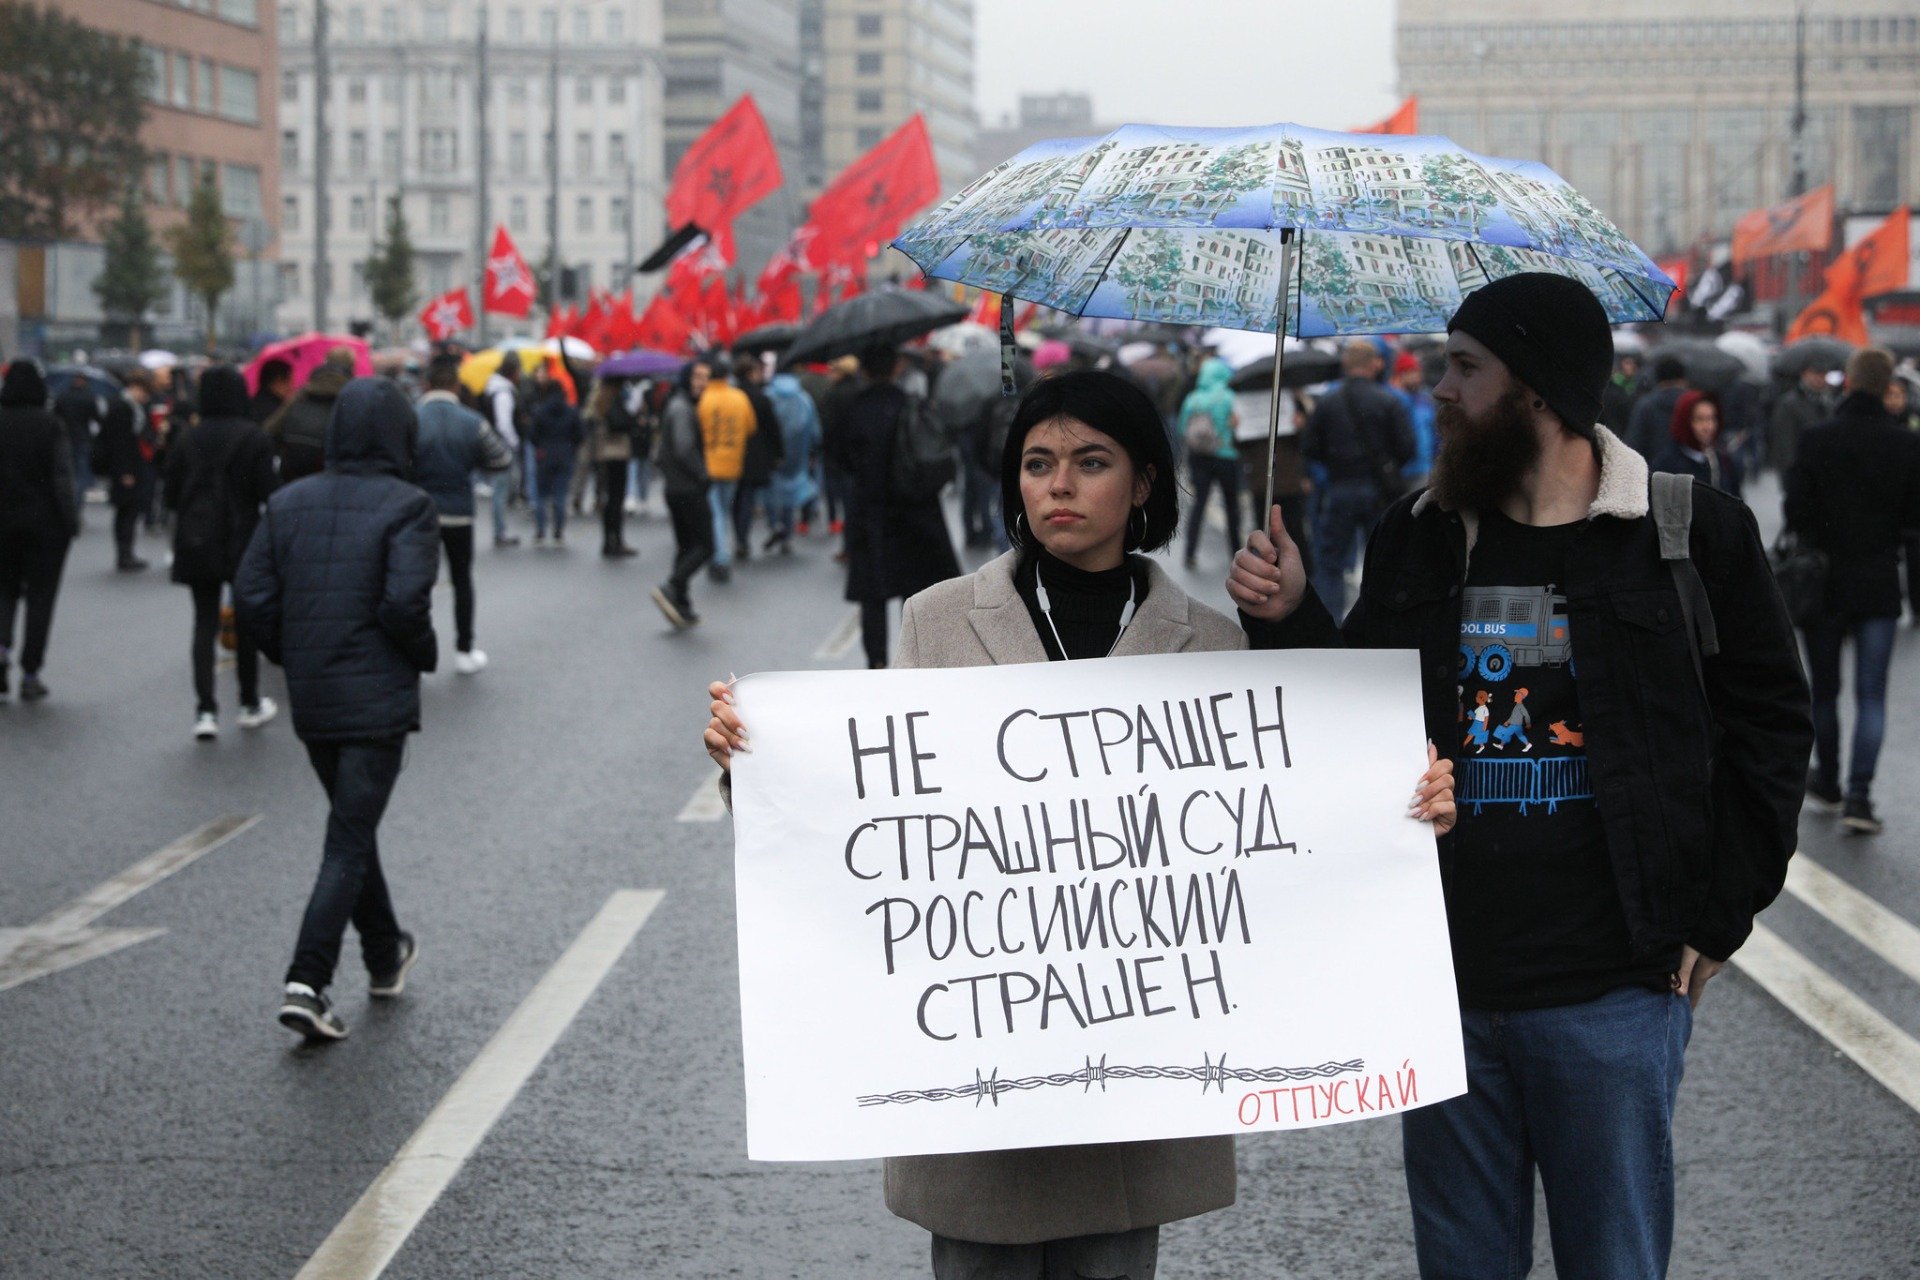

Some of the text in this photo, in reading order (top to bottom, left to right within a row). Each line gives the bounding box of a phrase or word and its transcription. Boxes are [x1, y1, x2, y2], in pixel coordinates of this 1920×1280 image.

[1484, 623, 1506, 634] BUS
[848, 685, 1292, 799] НЕ СТРАШЕН
[844, 783, 1313, 882] СТРАШНЫЙ СУД.
[865, 866, 1252, 975] РОССИЙСКИЙ
[916, 950, 1239, 1042] СТРАШЕН.
[1238, 1058, 1419, 1127] ОТПУСКАЙ
